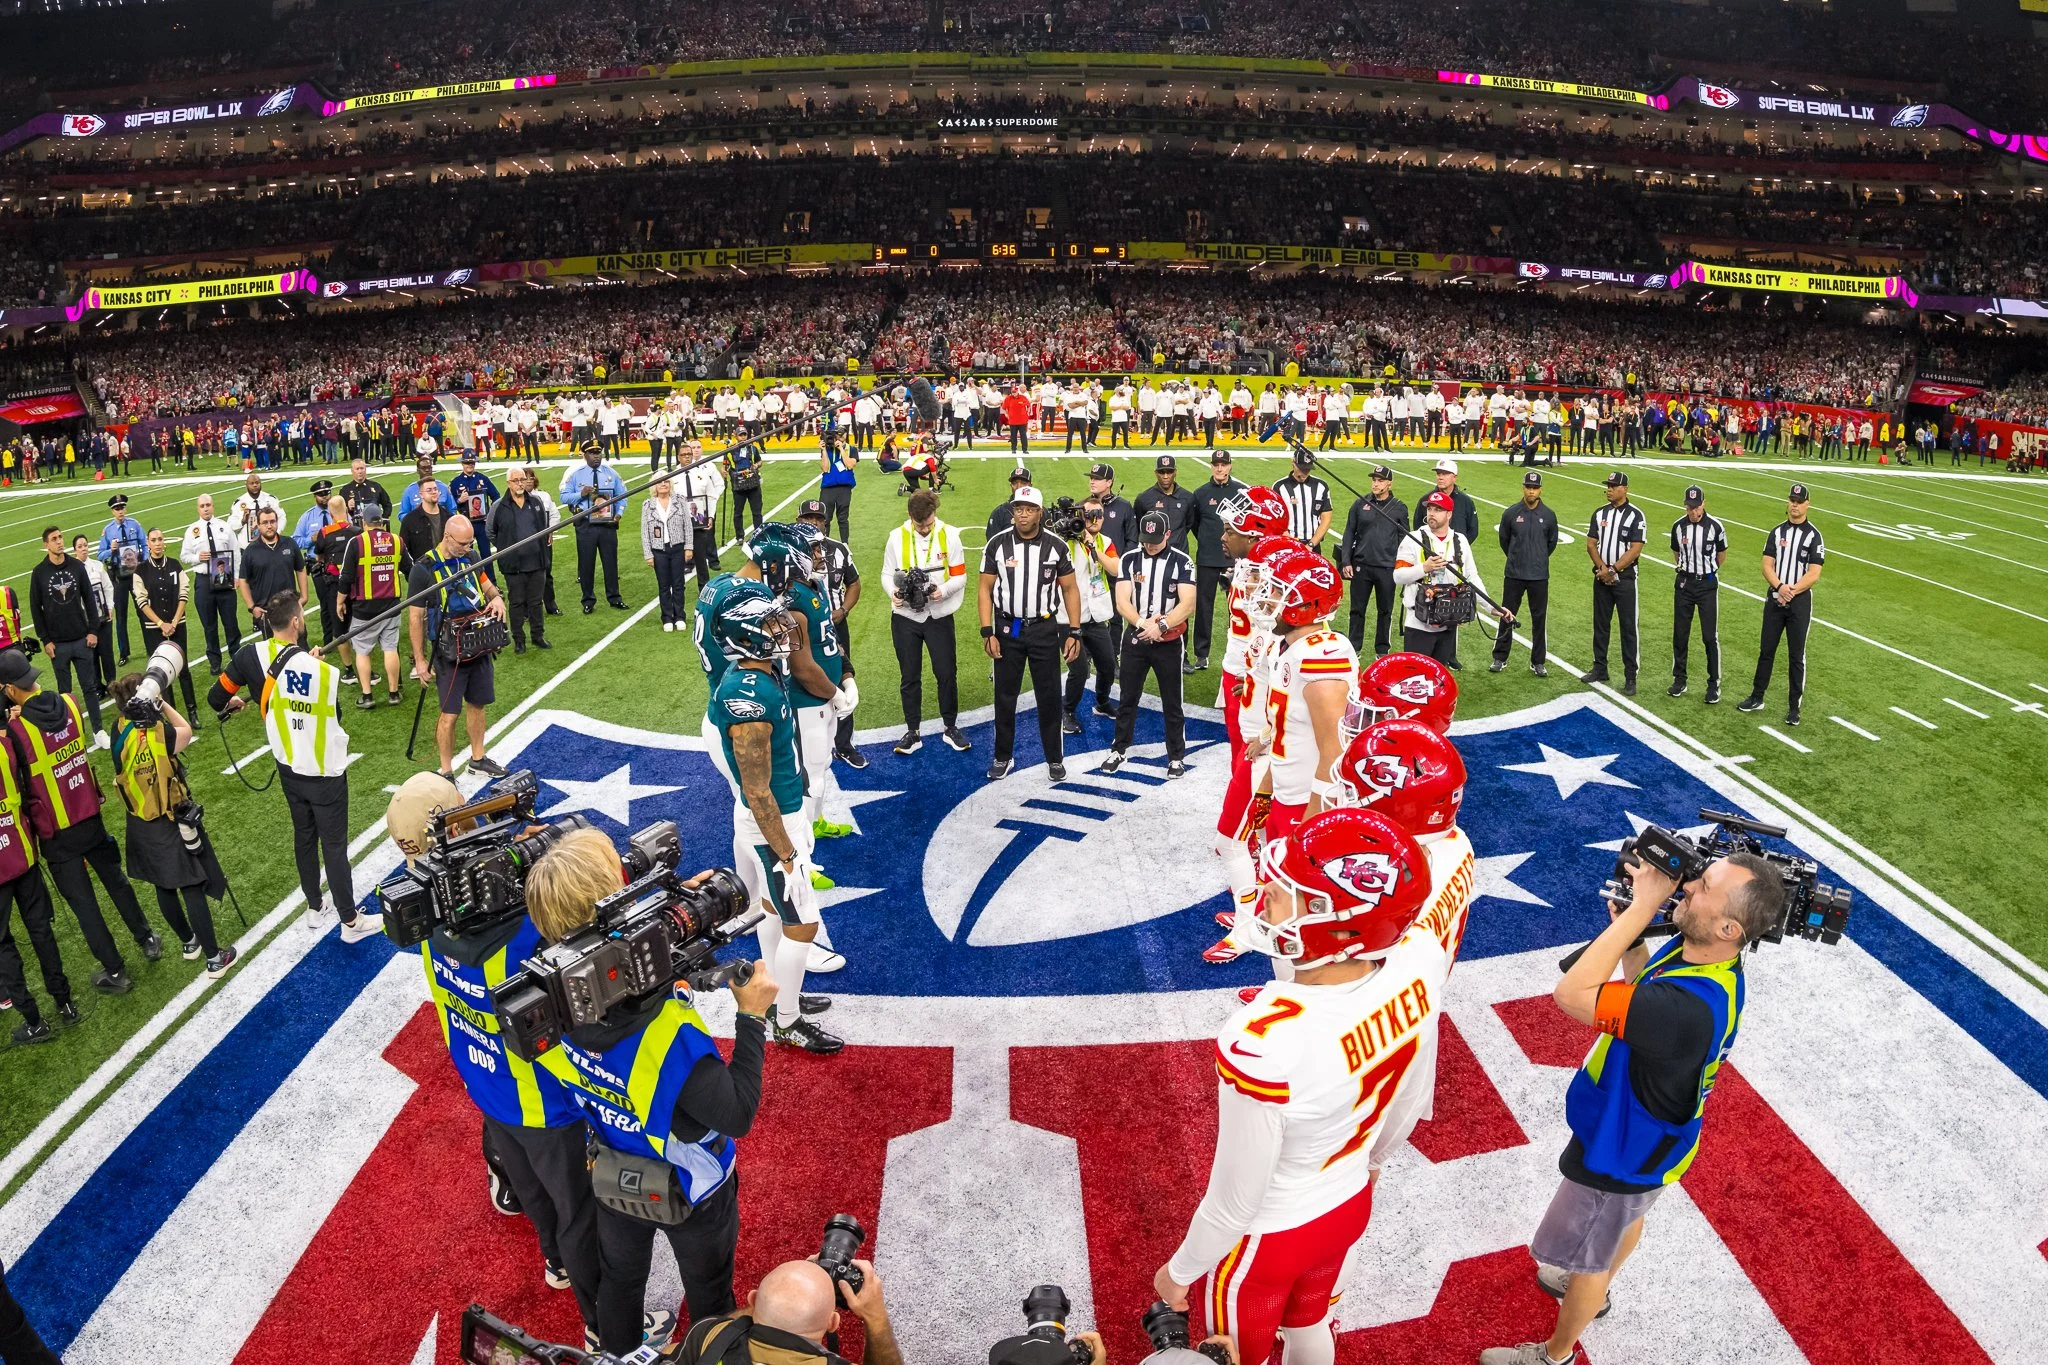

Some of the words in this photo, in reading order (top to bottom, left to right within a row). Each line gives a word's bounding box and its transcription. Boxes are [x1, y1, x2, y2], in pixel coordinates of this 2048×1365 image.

[355, 92, 390, 107] KANSAS
[393, 91, 414, 102] CITY
[436, 81, 501, 97] PHILADELPHIA
[1493, 76, 1530, 89] KANSAS
[1533, 81, 1555, 92] CITY
[1576, 85, 1637, 102] PHILADELPHIA
[124, 110, 170, 129] SUPER
[172, 105, 216, 123] BOWL
[218, 102, 243, 117] LIX
[1758, 96, 1804, 112] SUPER
[1807, 101, 1850, 118] BOWL
[1851, 105, 1875, 121] LIX
[938, 118, 994, 127] CAESARS
[995, 118, 1058, 126] SUPERDOME
[596, 253, 662, 271] KANSAS
[669, 251, 708, 267] CITY
[715, 248, 792, 265] CHIEFS
[875, 249, 882, 260] 3
[930, 245, 938, 256] 0
[992, 244, 1016, 256] 6:36
[1070, 244, 1077, 256] 0
[1118, 247, 1125, 258] 3
[1194, 245, 1333, 263] PHILADELPHIA
[1340, 250, 1420, 267] EAGLES
[359, 279, 388, 291] SUPER
[389, 277, 417, 288] BOWL
[418, 275, 434, 285] LIX
[1561, 268, 1590, 279] SUPER
[1592, 270, 1619, 282] BOWL
[1620, 273, 1635, 283] LIX
[1709, 269, 1752, 285] KANSAS
[1755, 273, 1781, 287] CITY
[1808, 277, 1881, 294] PHILADELPHIA
[103, 291, 143, 306] KANSAS
[146, 289, 171, 303] CITY
[198, 279, 275, 298] PHILADELPHIA
[1920, 372, 1951, 382] CAESARS
[1951, 376, 1985, 386] SUPERDOME
[375, 555, 393, 564] 00:00
[169, 570, 178, 585] 7
[378, 573, 390, 582] 026
[284, 669, 313, 697] N
[741, 673, 758, 686] 2
[54, 727, 70, 743] FOX
[1265, 688, 1289, 760] 7
[55, 740, 80, 763] 00:00
[54, 760, 74, 779] CAMERA
[68, 773, 85, 791] 024
[432, 958, 486, 999] FILMS
[447, 991, 487, 1030] 00:00
[1244, 996, 1306, 1039] 7
[450, 1012, 501, 1055] CAMERA
[1339, 978, 1431, 1075] BUTKER
[1319, 1032, 1421, 1172] 7
